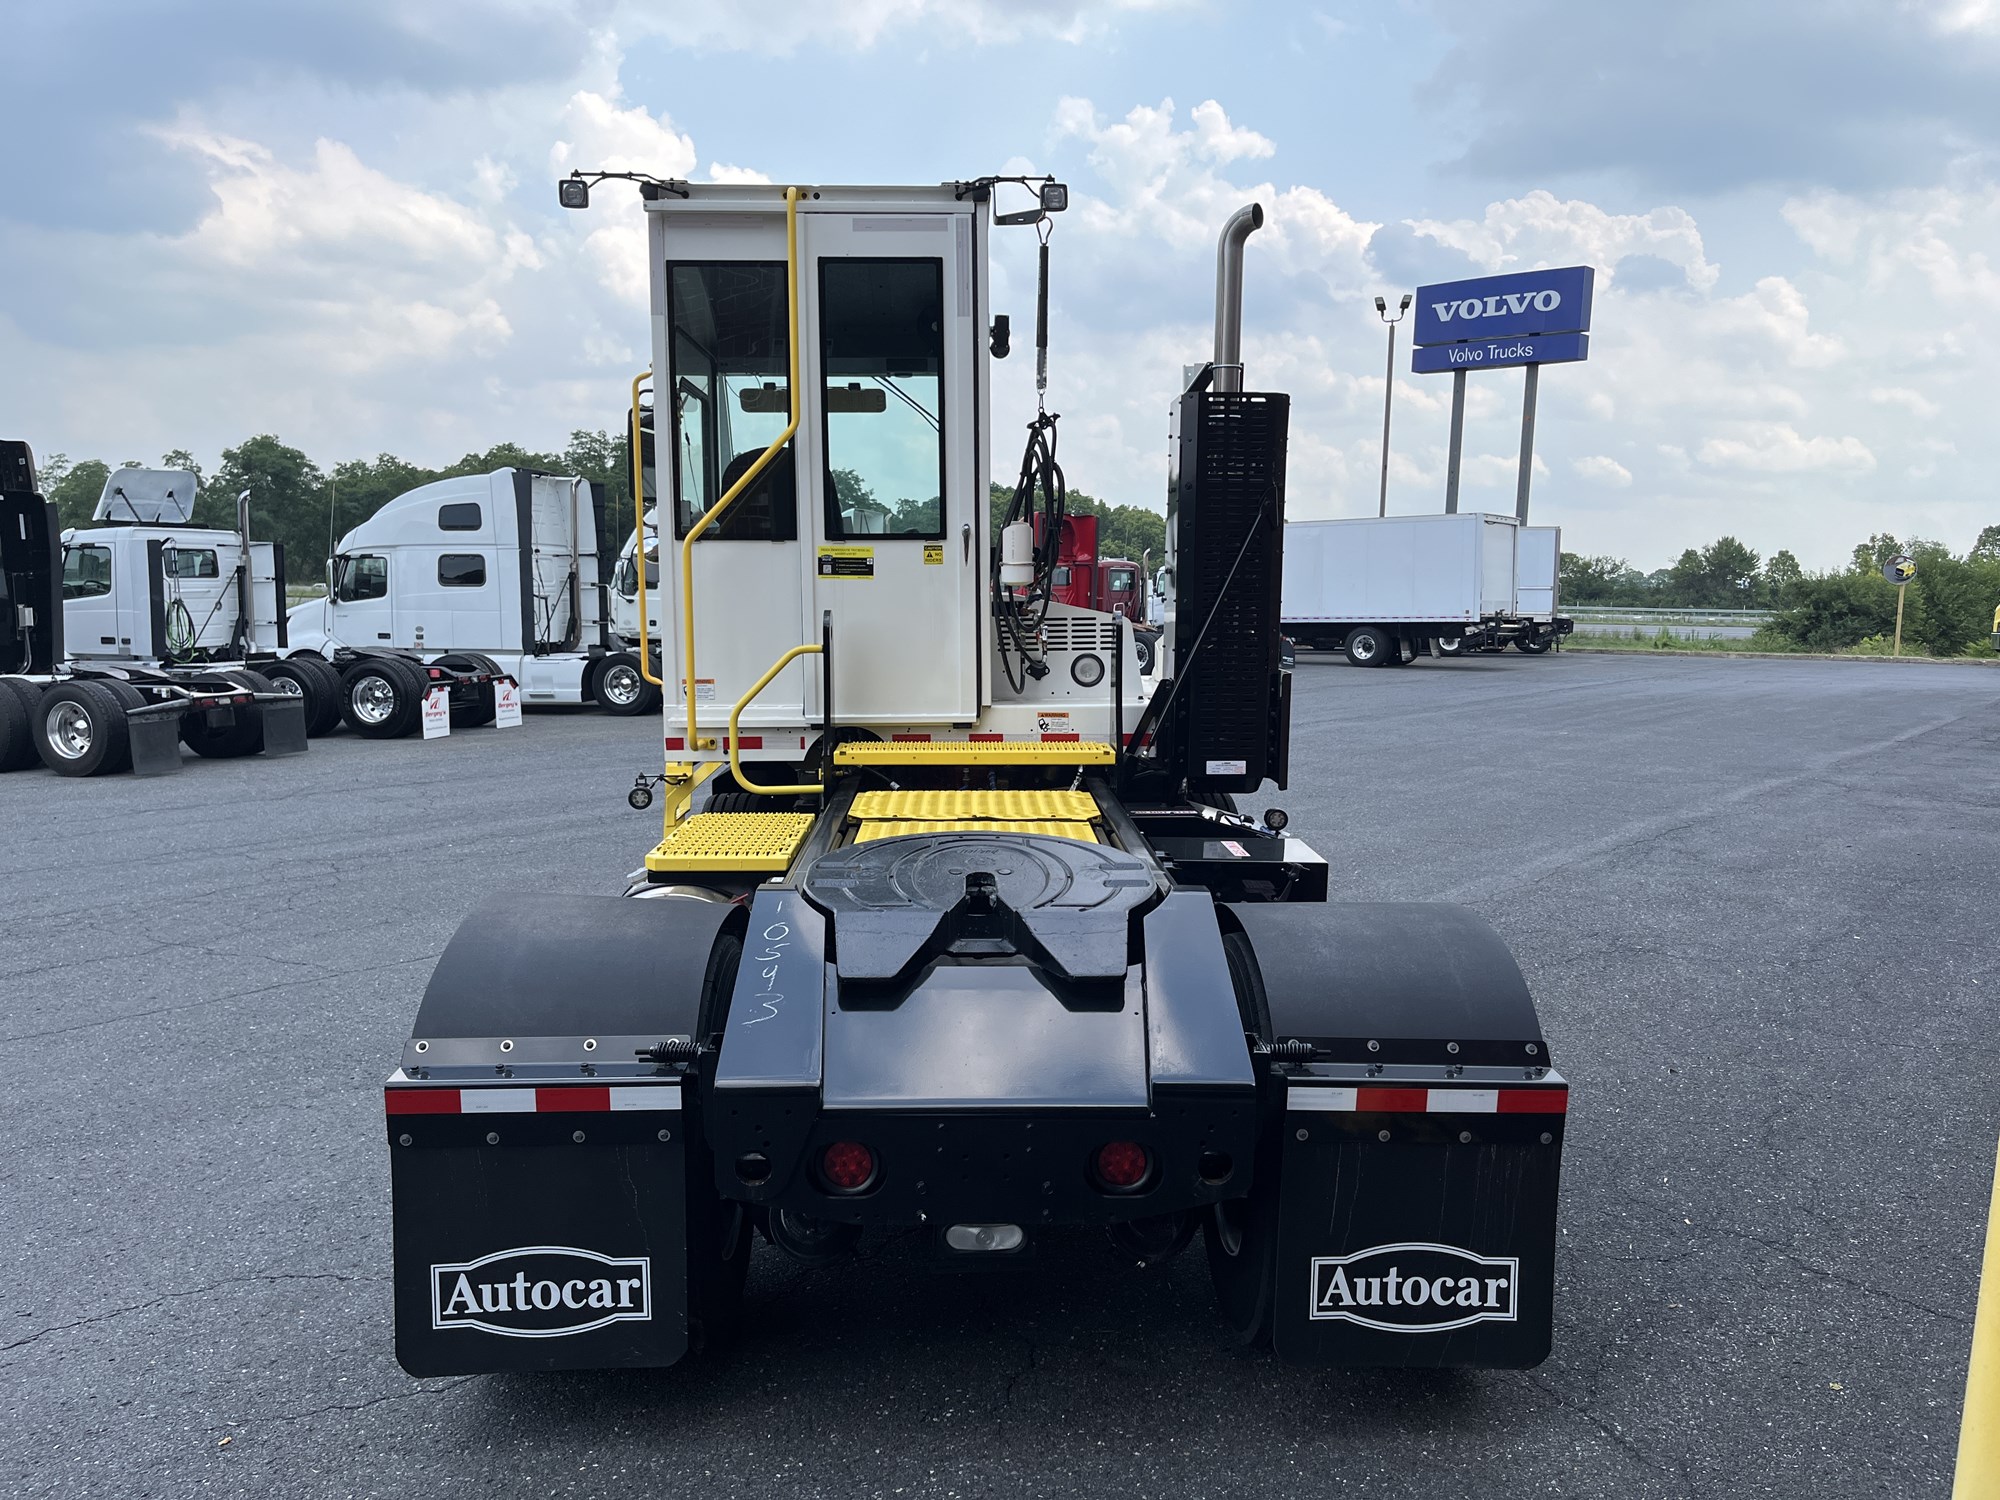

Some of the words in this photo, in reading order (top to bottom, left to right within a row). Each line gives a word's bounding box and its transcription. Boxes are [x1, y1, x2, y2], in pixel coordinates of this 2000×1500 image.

[1431, 289, 1562, 323] VOLVO
[1448, 346, 1484, 364] Volvo
[1487, 342, 1534, 360] Trucks
[442, 1271, 641, 1316] Autocar
[1319, 1265, 1509, 1308] Autocar
